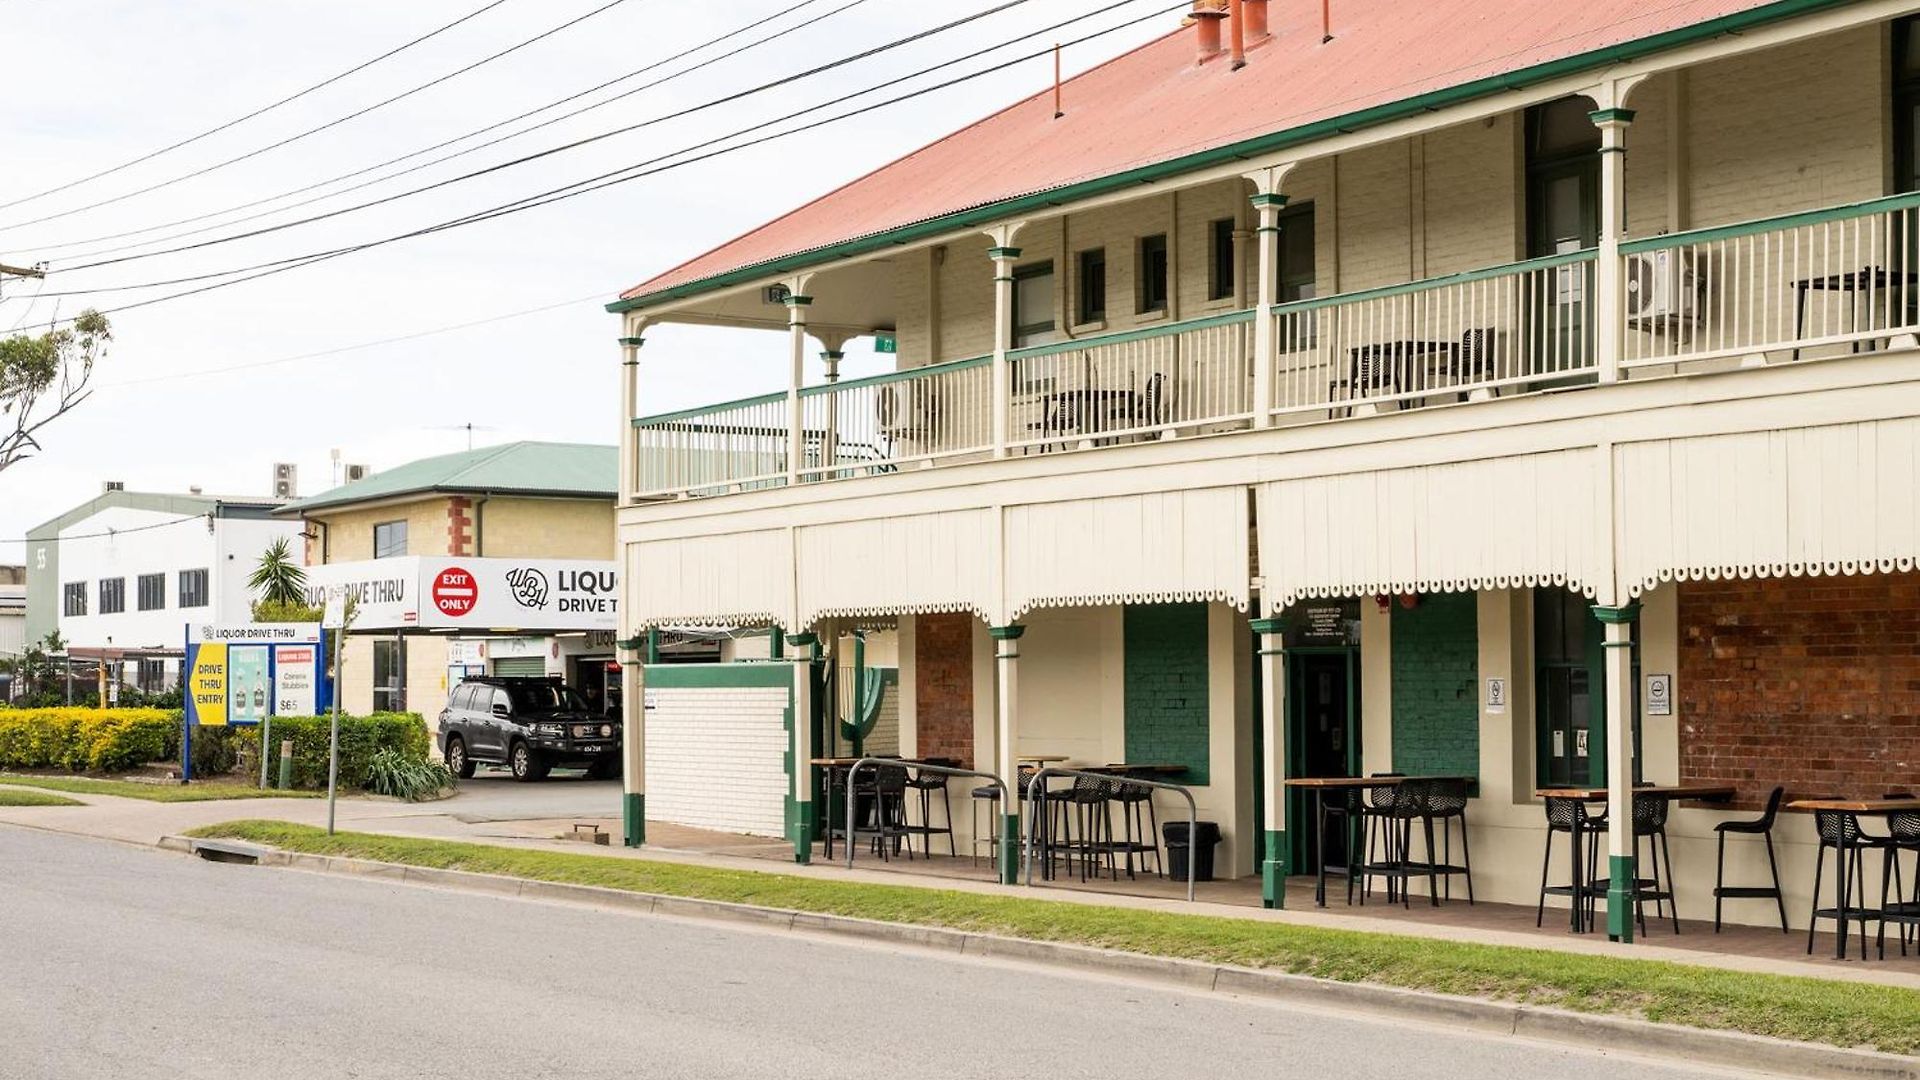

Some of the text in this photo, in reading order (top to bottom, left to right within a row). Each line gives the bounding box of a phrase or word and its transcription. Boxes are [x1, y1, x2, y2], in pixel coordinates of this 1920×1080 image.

[37, 547, 46, 570] 55
[442, 574, 468, 585] EXIT
[558, 570, 618, 596] LIQU
[344, 581, 369, 604] RIVE
[372, 579, 404, 603] THRU
[440, 599, 470, 609] ONLY
[558, 598, 605, 612] DRIVE
[216, 629, 246, 638] LIQUOR
[248, 629, 271, 638] DRIVE
[274, 628, 295, 638] THRU
[198, 664, 223, 674] DRIVE
[199, 679, 222, 689] THRU
[197, 694, 224, 704] ENTRY
